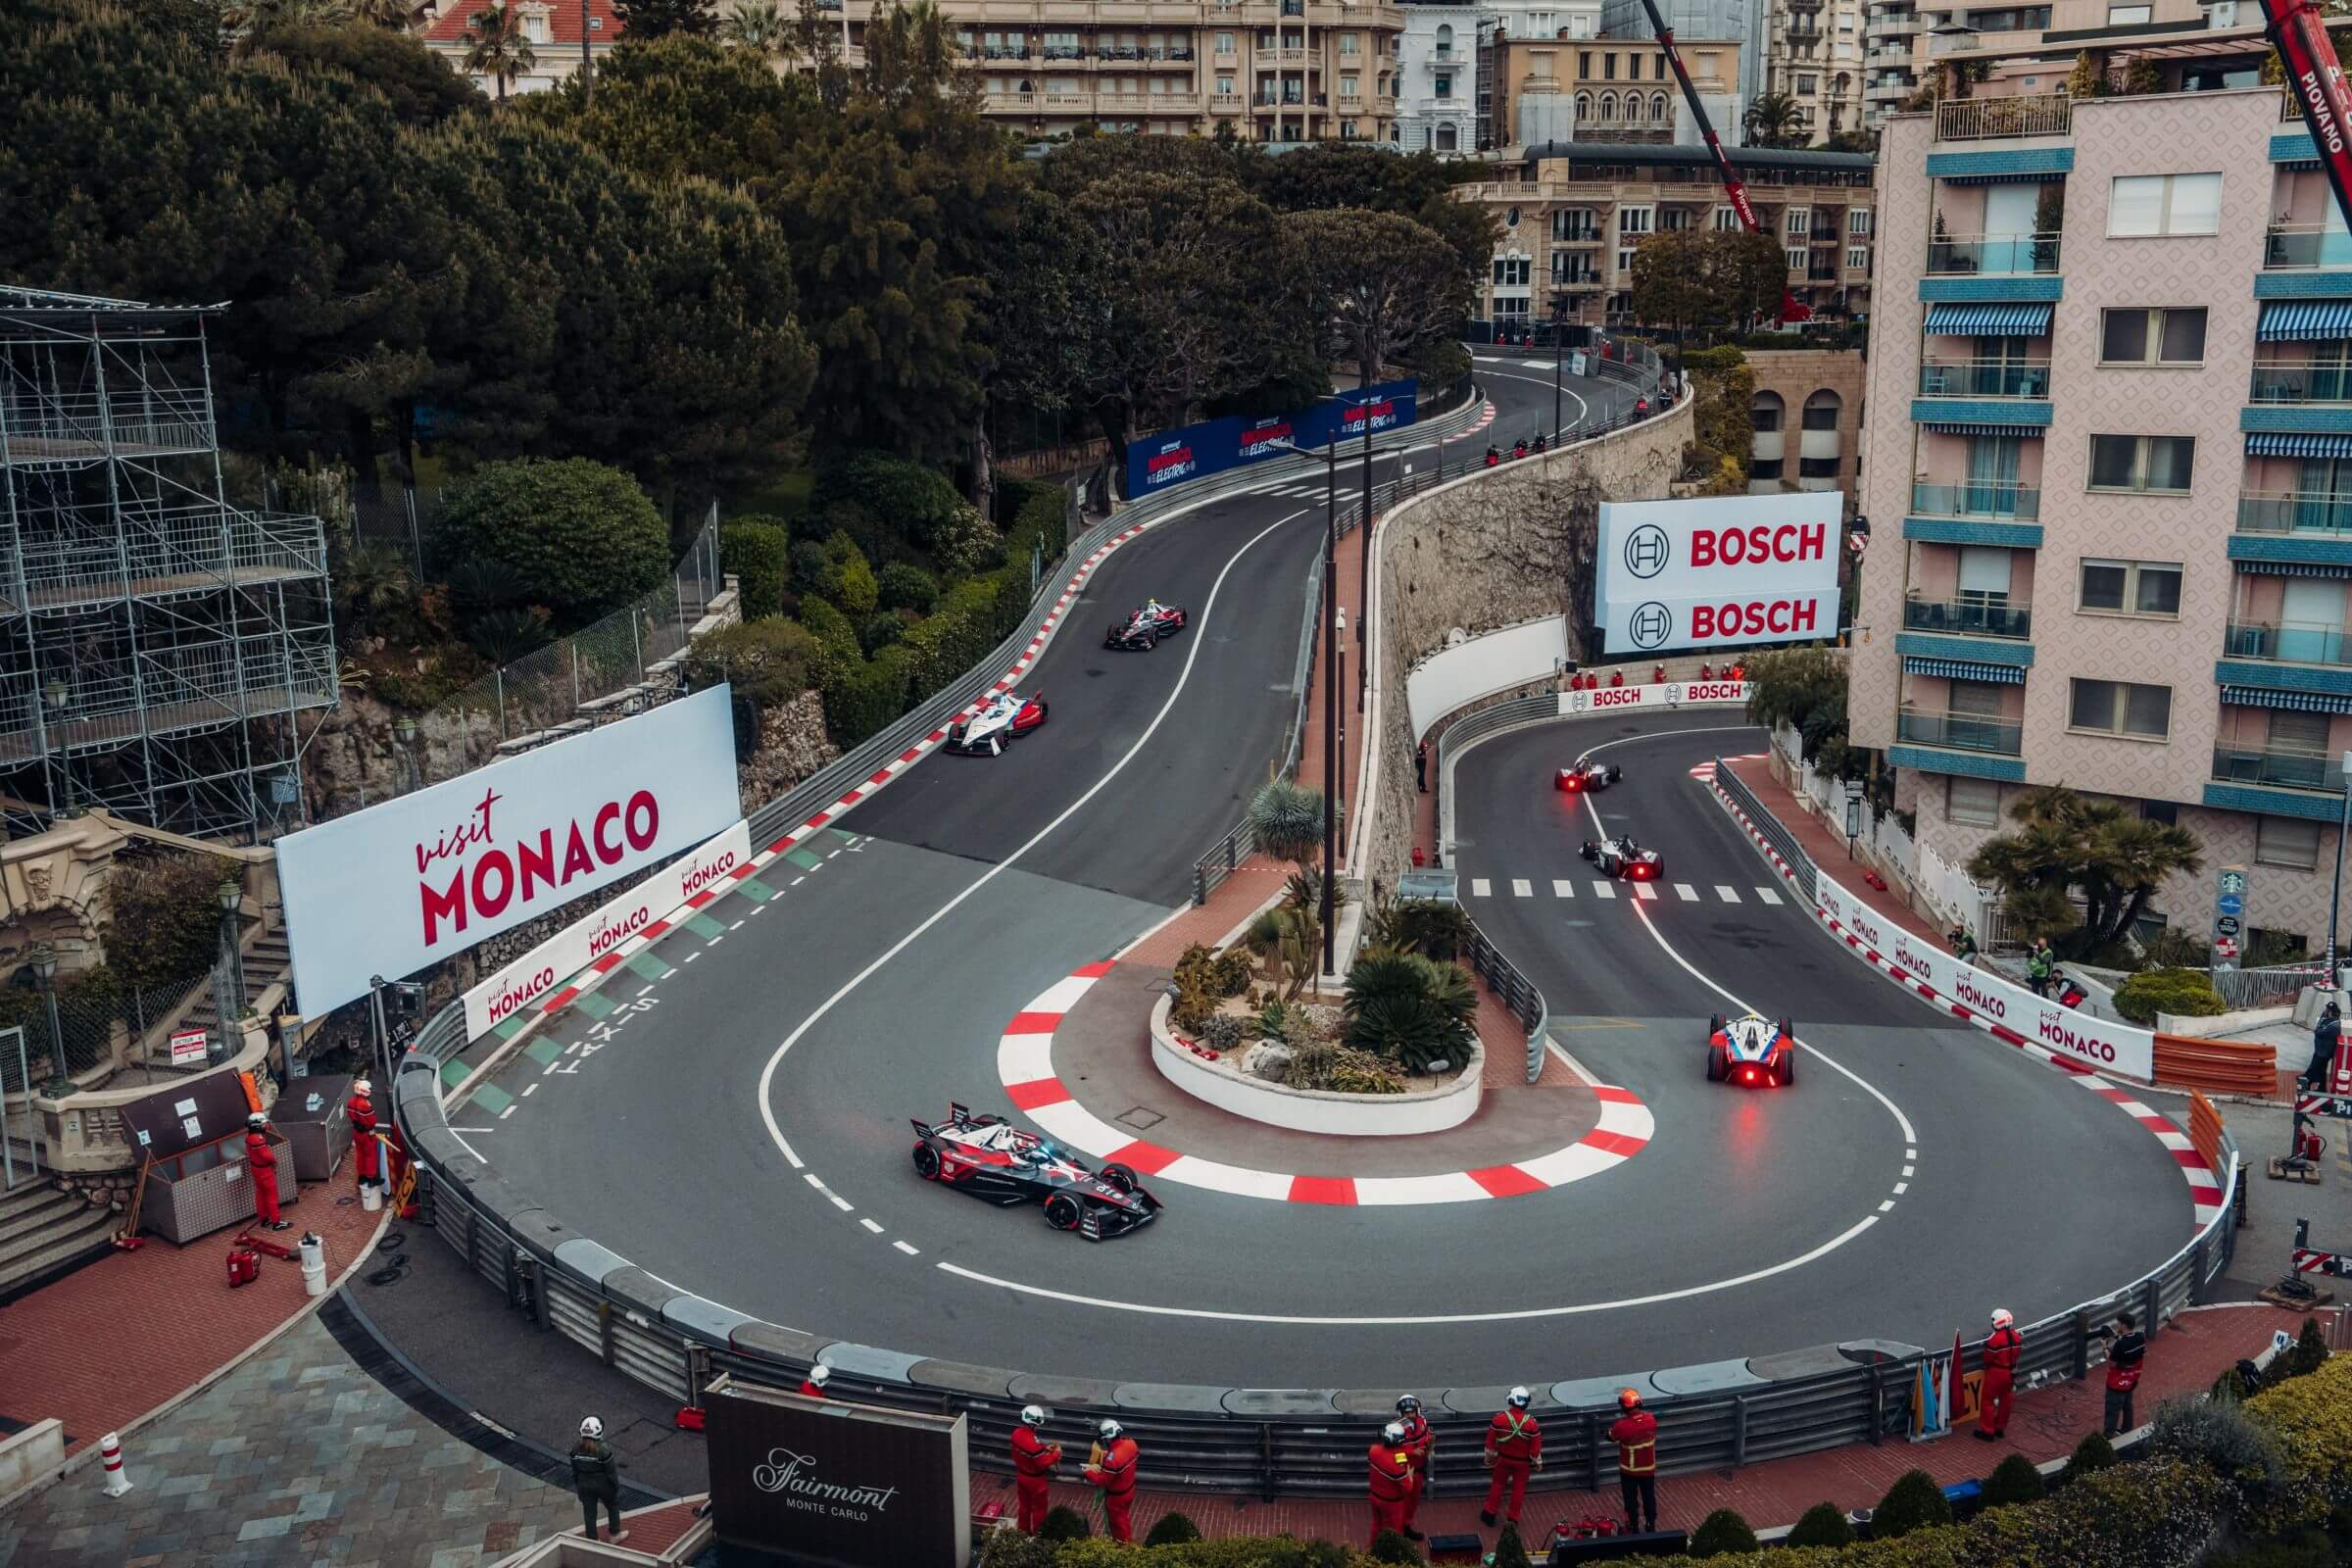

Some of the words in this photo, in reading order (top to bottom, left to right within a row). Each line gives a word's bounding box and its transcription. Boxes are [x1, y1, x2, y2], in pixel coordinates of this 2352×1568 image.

[2302, 70, 2343, 154] PIOVANO
[1737, 189, 1756, 224] Piovano
[1690, 523, 1826, 567] BOSCH
[1691, 599, 1818, 638] BOSCH
[1593, 688, 1641, 707] BOSCH
[1689, 685, 1741, 700] BOSCH
[416, 787, 503, 874] visit
[419, 790, 660, 947] MONACO
[682, 851, 735, 897] MONACO
[1821, 890, 1839, 917] MONACO
[588, 912, 610, 940] visit
[590, 906, 649, 956] MONACO
[1851, 914, 1879, 946] MONACO
[1895, 948, 1932, 979] MONACO
[487, 976, 511, 1004] visit
[489, 967, 555, 1024] MONACO
[1956, 981, 2006, 1019] MONACO
[2039, 1008, 2064, 1023] visit
[2039, 1020, 2116, 1063] MONACO
[753, 1447, 901, 1511] Fairmont
[786, 1497, 826, 1514] MONTE
[831, 1506, 868, 1522] CARLO
